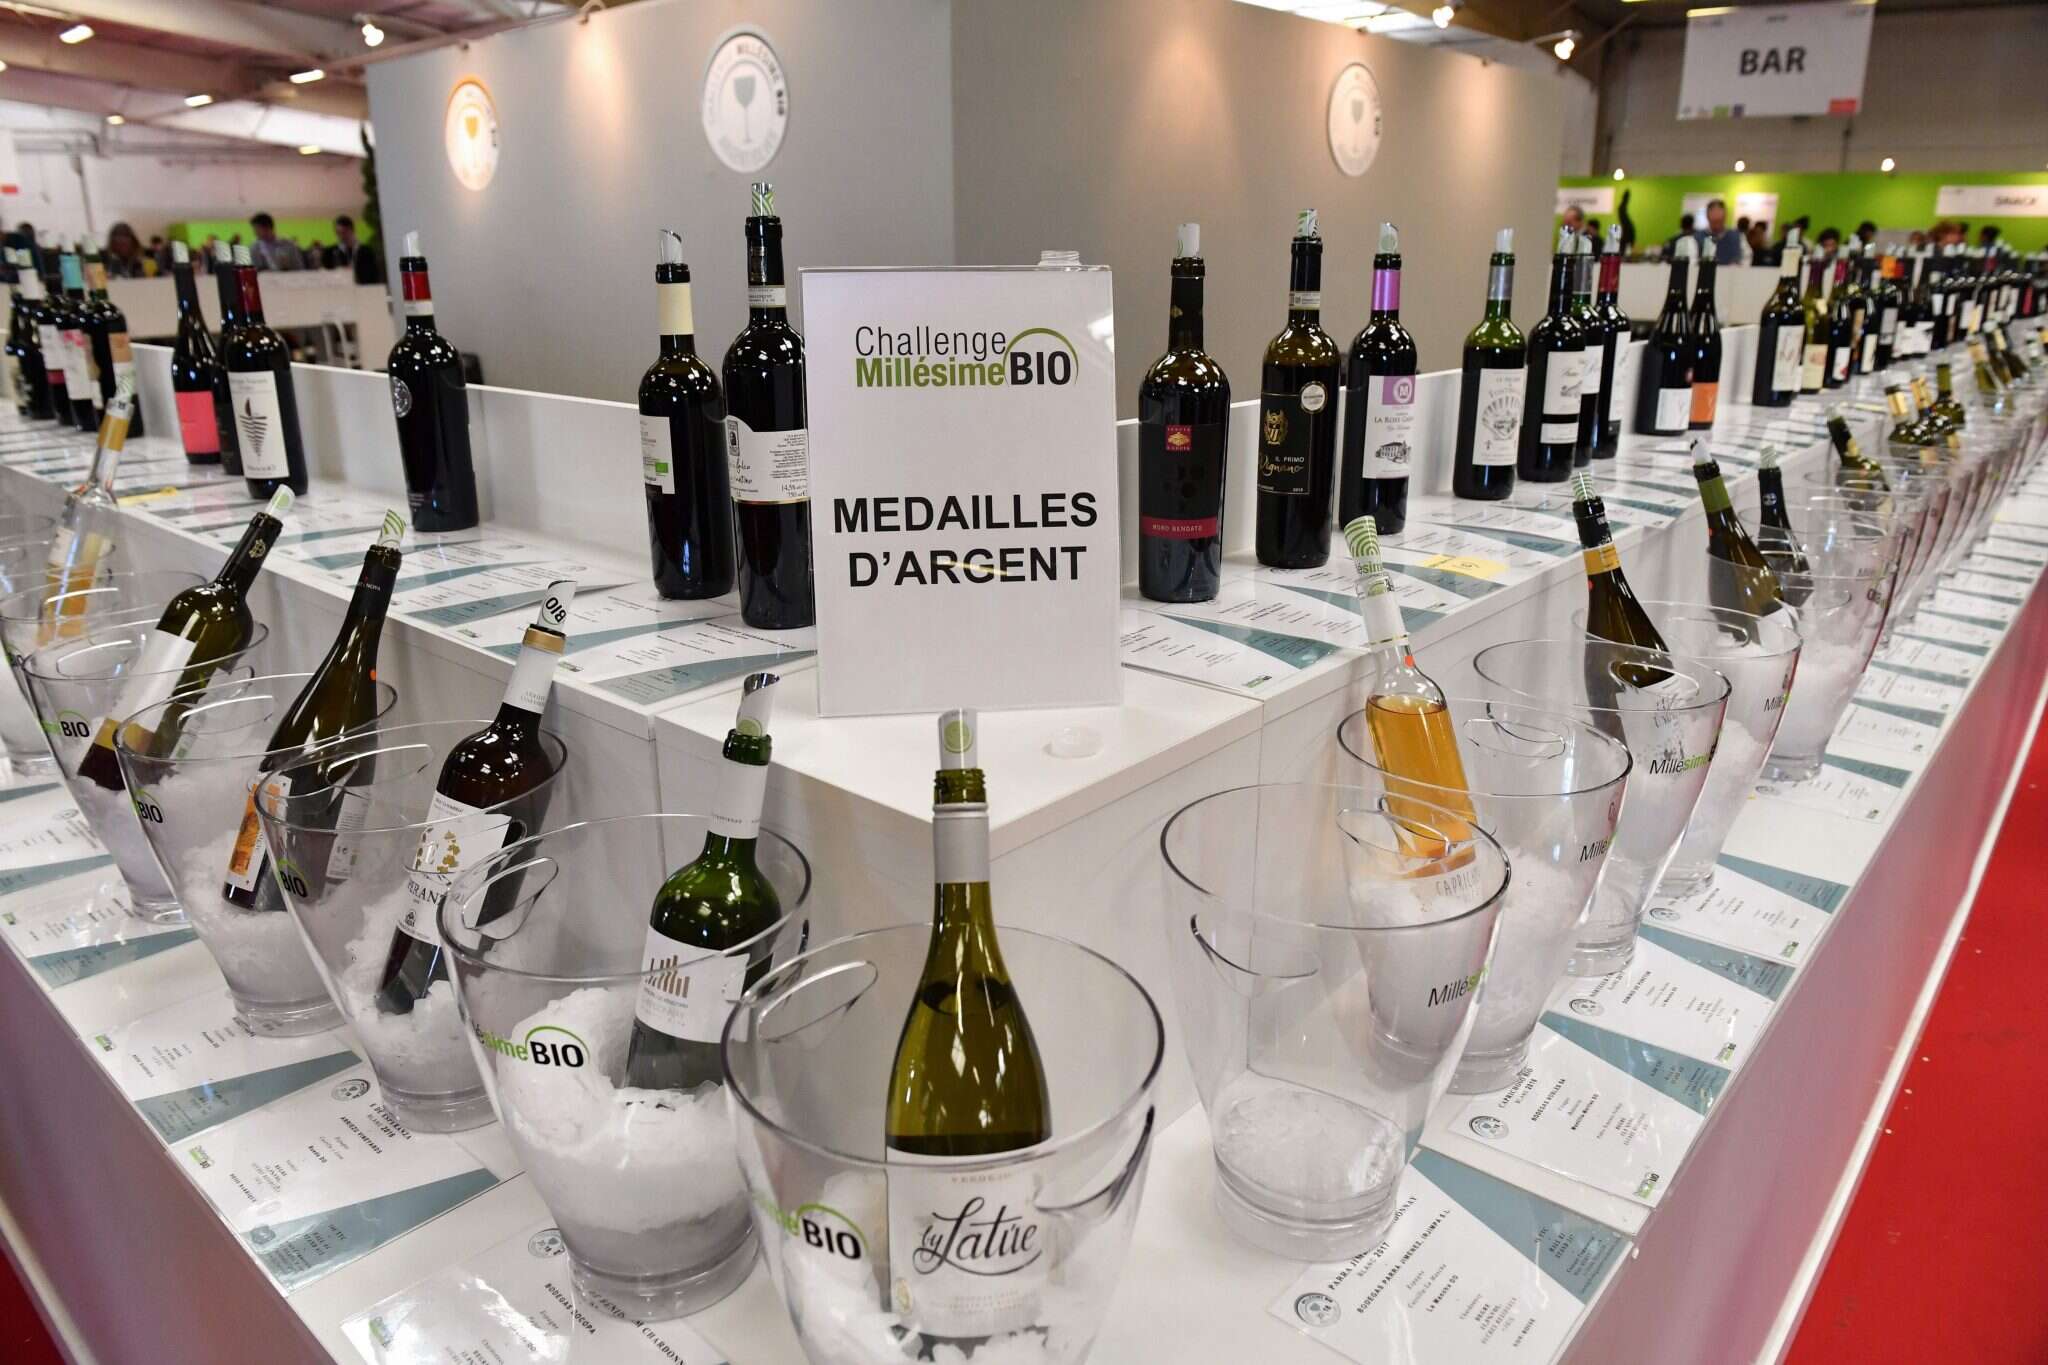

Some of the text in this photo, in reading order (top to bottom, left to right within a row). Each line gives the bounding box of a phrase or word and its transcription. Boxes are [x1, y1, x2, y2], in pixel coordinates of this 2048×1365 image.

[1740, 46, 1807, 76] BAR
[855, 326, 1006, 361] Challenge
[833, 491, 1098, 533] MEDAILLES
[849, 546, 1087, 587] D’ARGENT
[530, 1041, 585, 1068] BIO
[1531, 1101, 1548, 1120] BODEGAS
[802, 1217, 862, 1260] BIO
[1373, 1241, 1389, 1258] 2017
[1328, 1265, 1351, 1290] PARRA
[1356, 1284, 1383, 1313] BODEGAS
[1382, 1265, 1400, 1284] PARRA
[544, 1283, 573, 1310] BODEGAS
